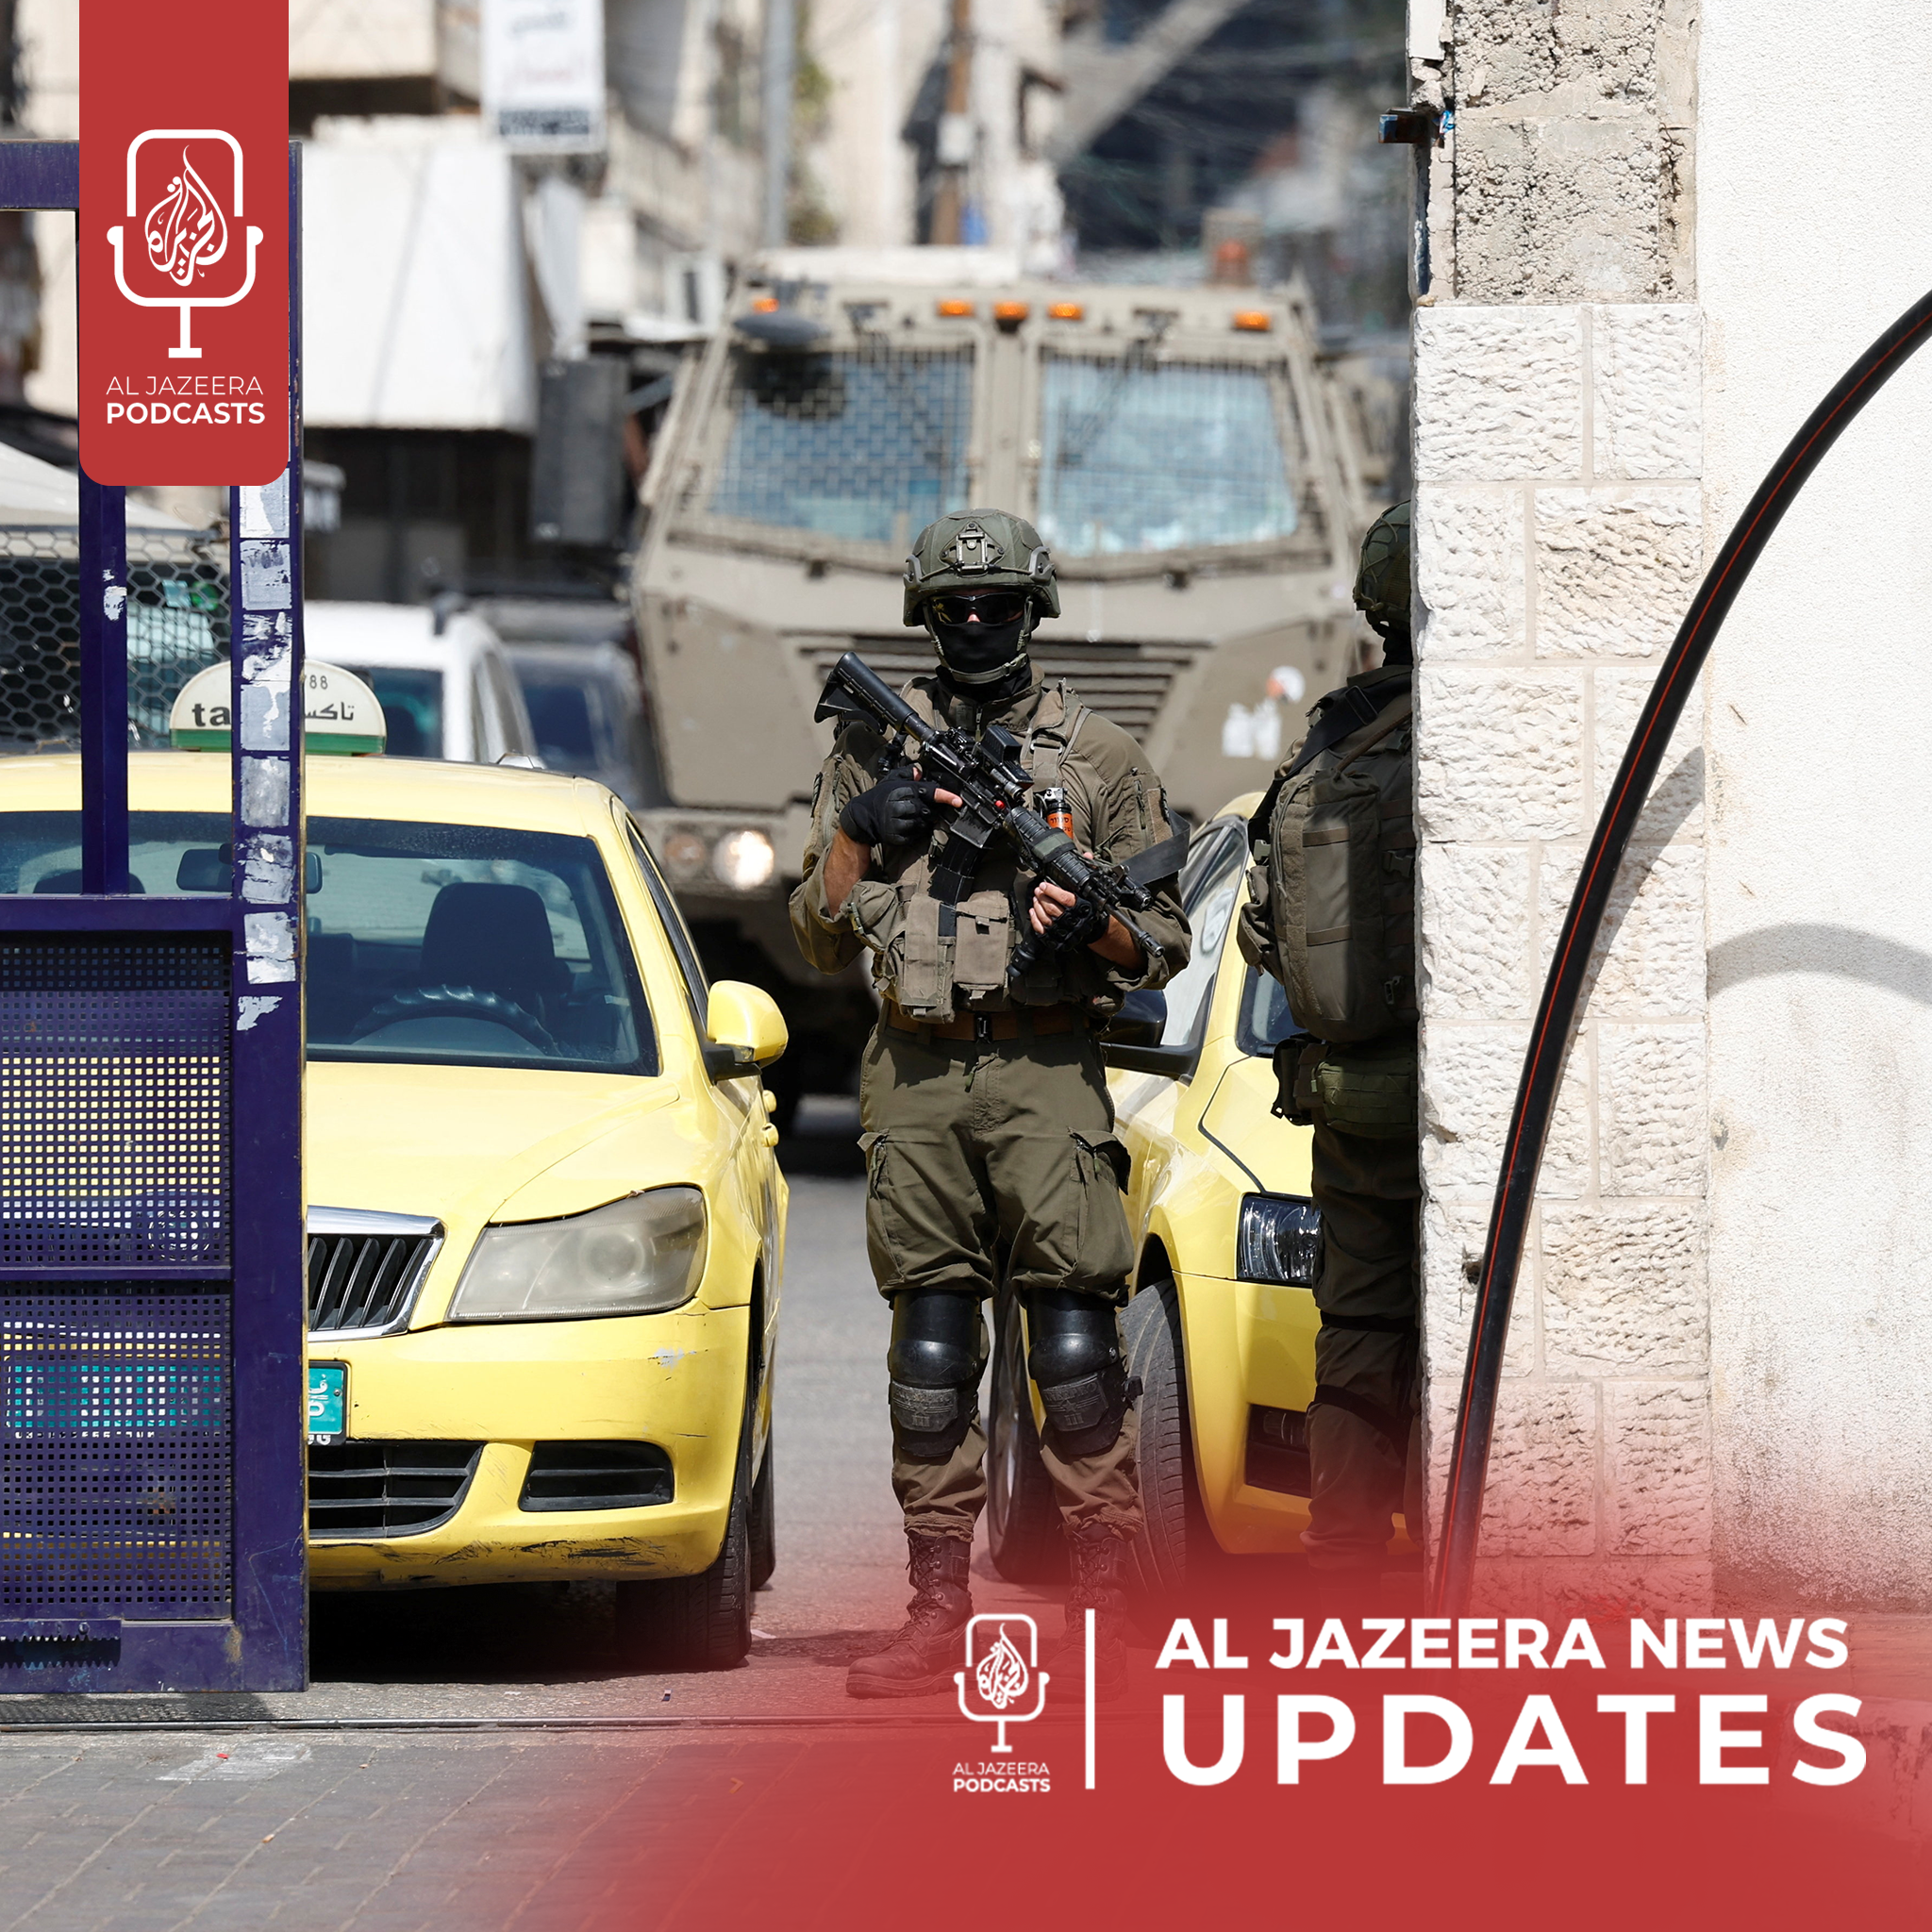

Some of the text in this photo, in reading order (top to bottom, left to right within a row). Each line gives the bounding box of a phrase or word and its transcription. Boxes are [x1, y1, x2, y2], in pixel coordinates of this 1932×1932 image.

[305, 674, 329, 691] 88
[192, 703, 231, 727] ta
[305, 701, 356, 721] تاكس
